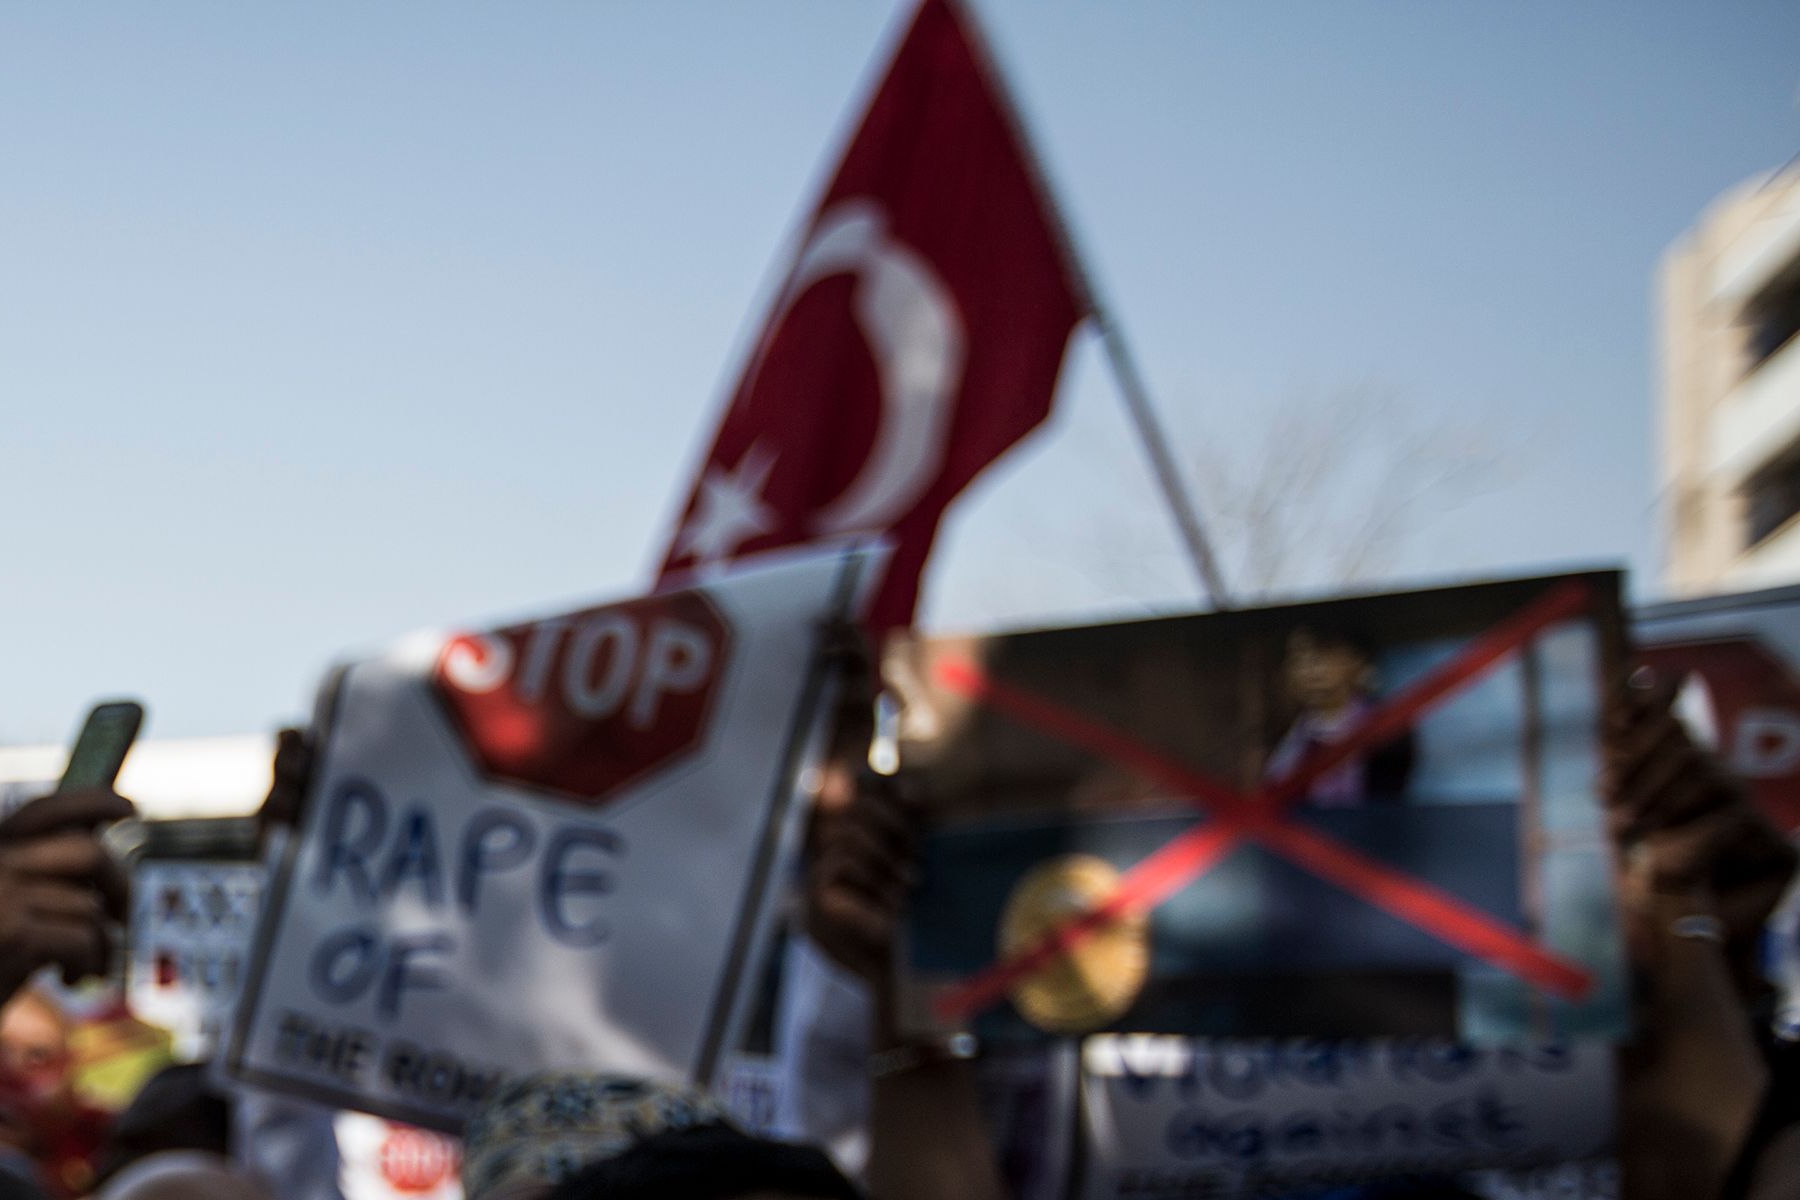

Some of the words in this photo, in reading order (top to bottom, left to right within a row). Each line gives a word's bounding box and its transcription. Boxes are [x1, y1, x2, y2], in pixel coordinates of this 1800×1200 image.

[441, 612, 712, 728] STOP
[312, 775, 631, 950] RAPE
[309, 925, 458, 1020] OF
